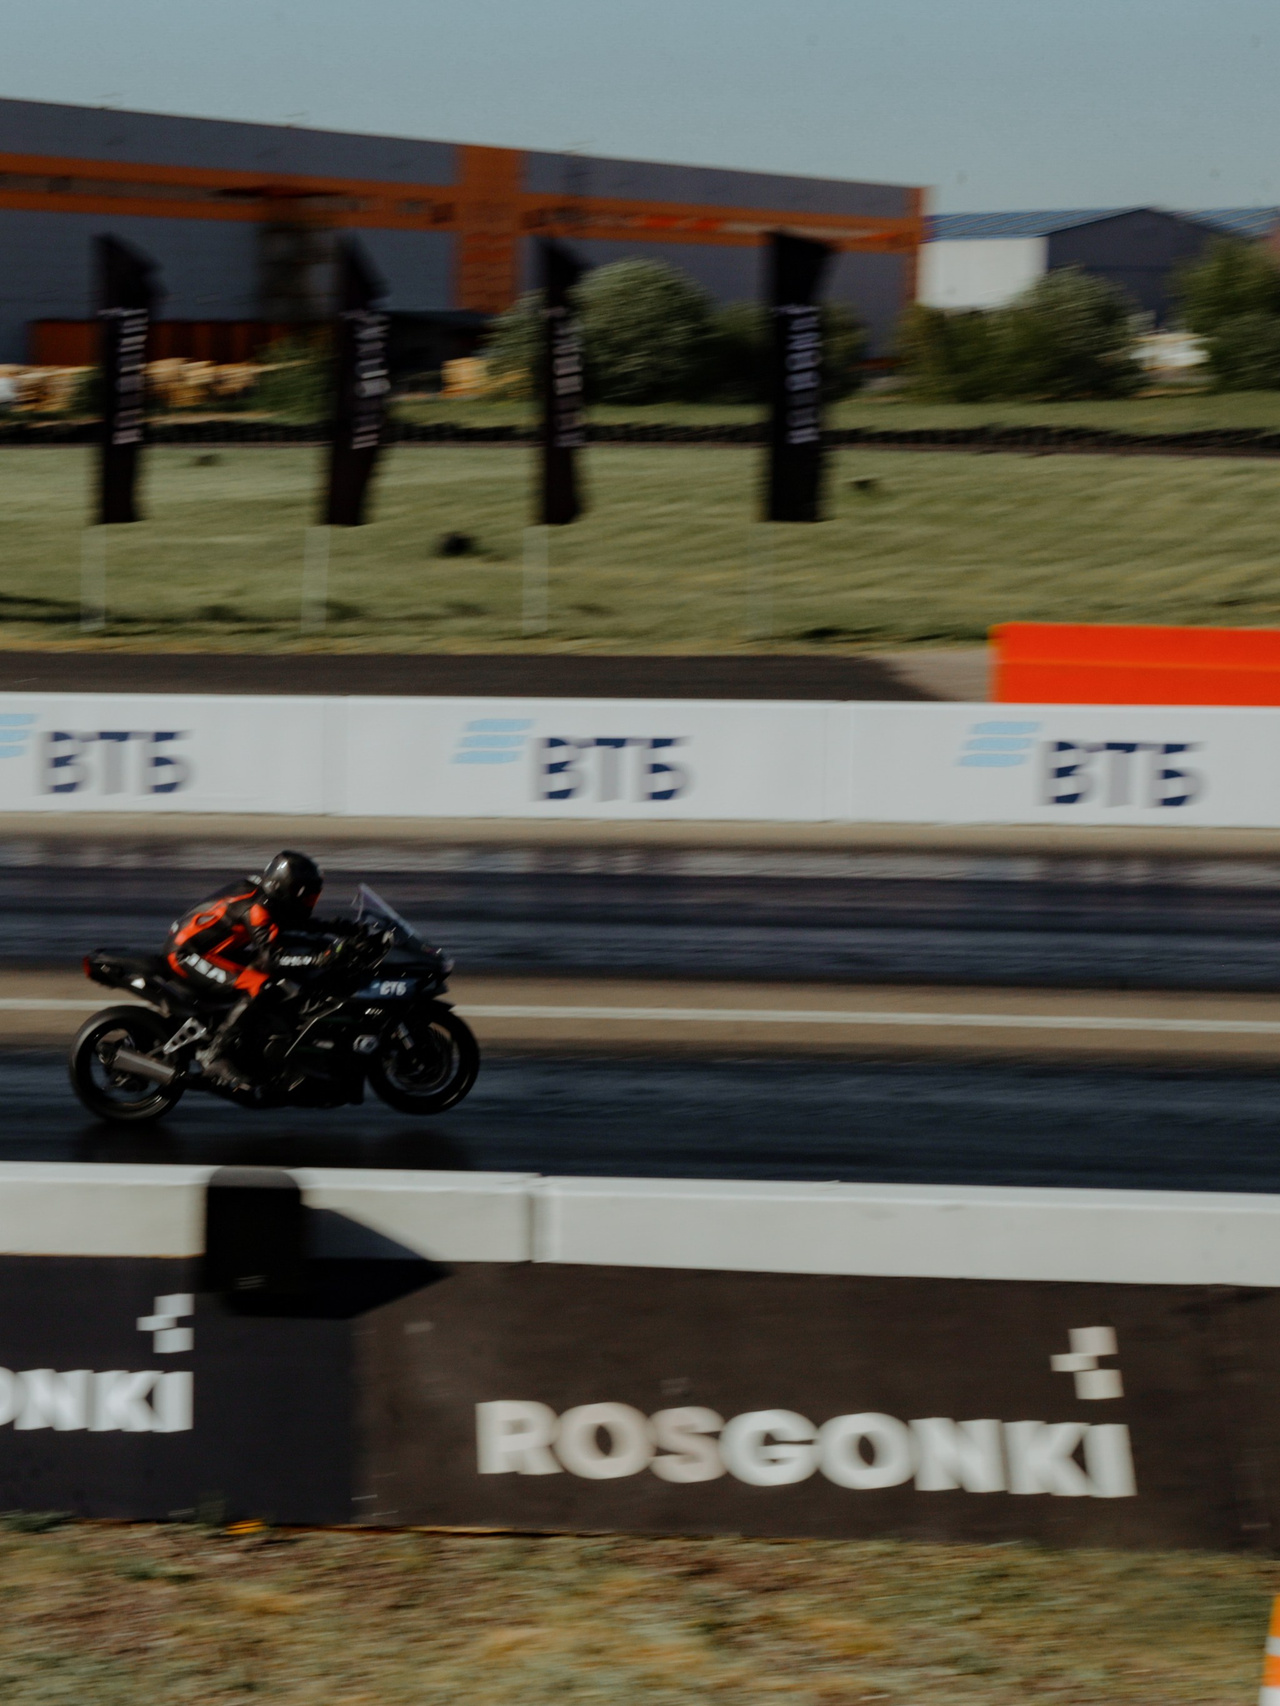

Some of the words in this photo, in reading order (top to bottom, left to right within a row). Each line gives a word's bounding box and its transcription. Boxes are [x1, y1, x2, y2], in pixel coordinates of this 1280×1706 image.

[36, 729, 193, 795] ВТБ
[530, 736, 693, 801] ВТБ
[1034, 741, 1206, 807] ВТБ
[475, 1400, 1137, 1499] ROSGONKI
